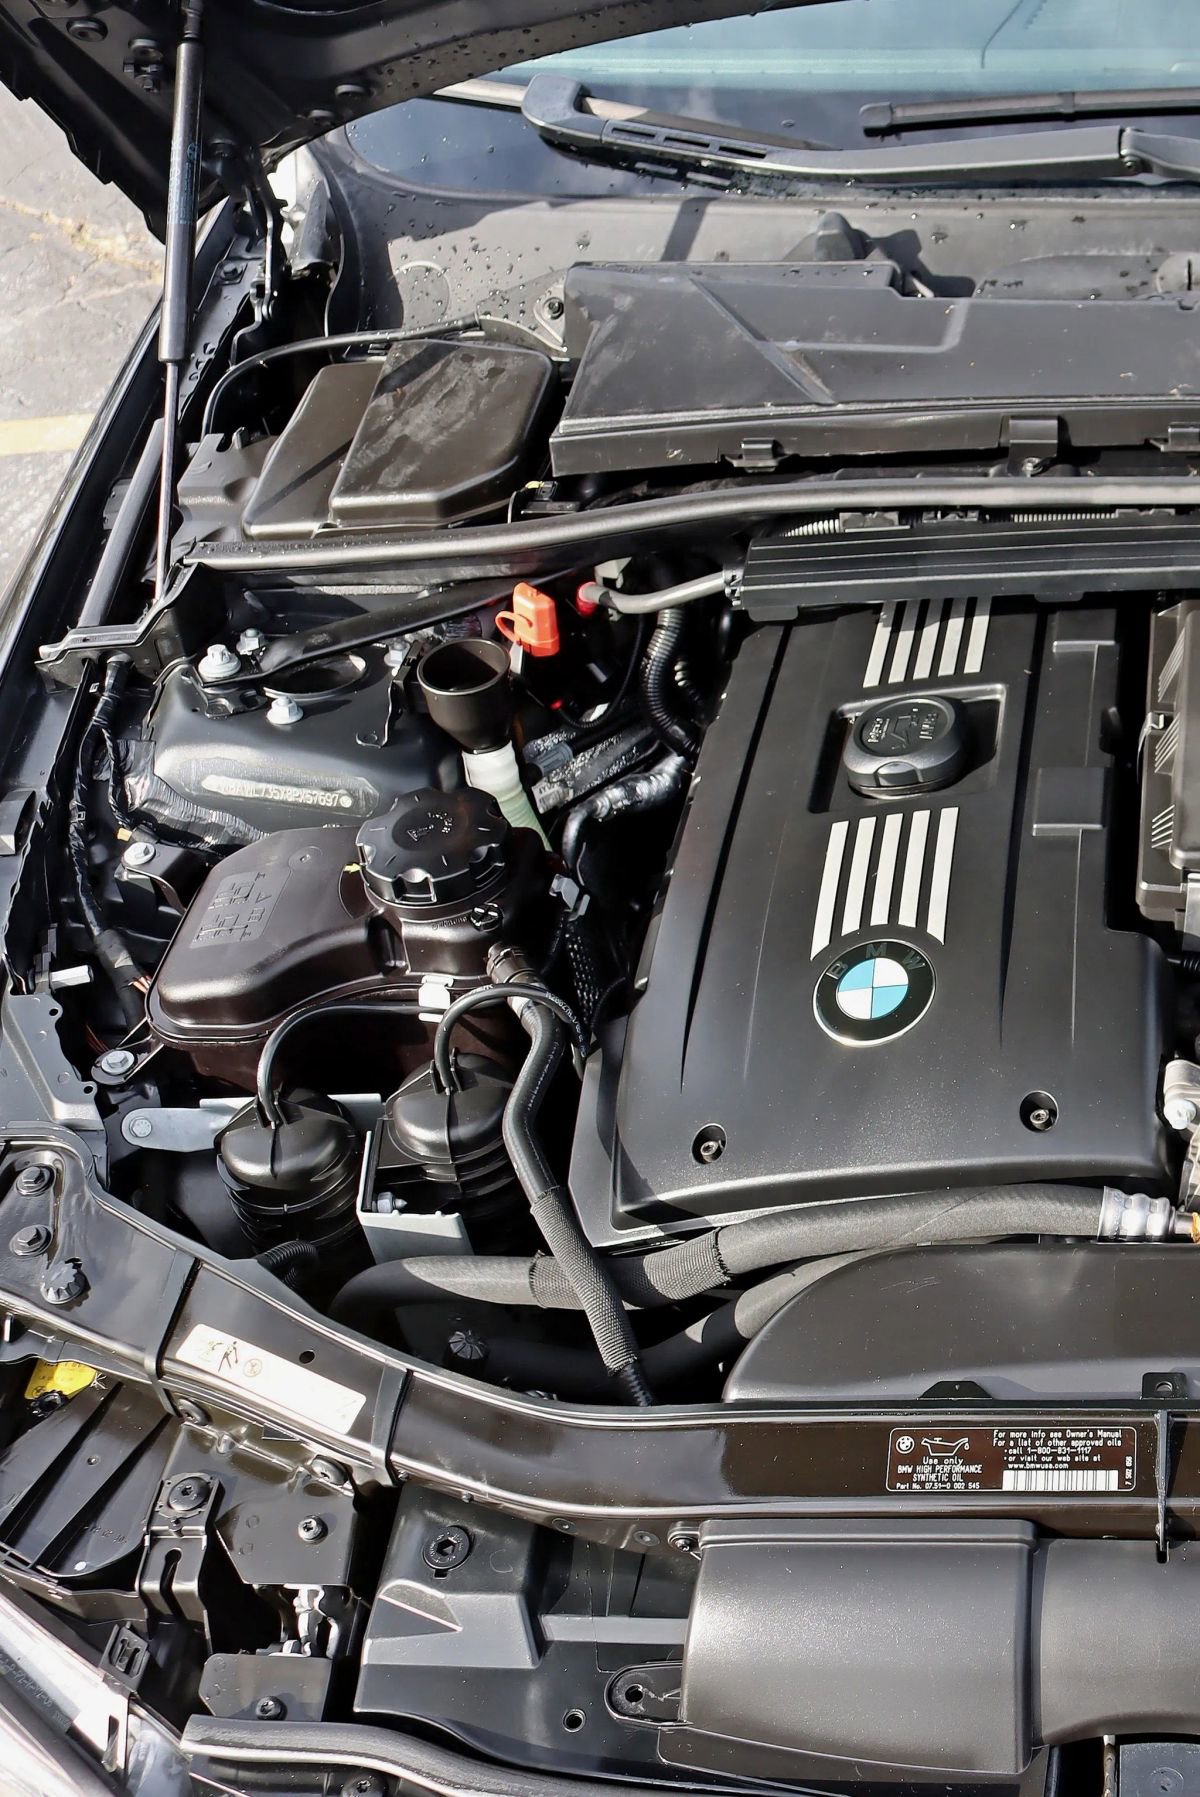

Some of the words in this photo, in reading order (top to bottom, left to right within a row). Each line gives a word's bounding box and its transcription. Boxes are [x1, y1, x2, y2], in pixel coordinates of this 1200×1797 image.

[825, 942, 927, 980] BMW
[993, 1429, 1006, 1438] For
[1031, 1429, 1046, 1438] info
[1066, 1429, 1094, 1438] Owner's
[1097, 1429, 1122, 1438] Manual
[993, 1438, 1006, 1447] For
[1018, 1438, 1031, 1447] list
[1035, 1438, 1044, 1447] of
[1047, 1438, 1067, 1447] other
[1071, 1437, 1104, 1448] approved
[1107, 1438, 1122, 1447] oils
[1027, 1446, 1092, 1454] 1-800-831-1117
[922, 1456, 939, 1465] Use
[943, 1456, 964, 1467] only
[1020, 1454, 1037, 1462] visit
[1057, 1454, 1071, 1462] web
[1074, 1454, 1089, 1462] site
[1093, 1454, 1101, 1462] at
[897, 1464, 913, 1474] BMW
[916, 1464, 933, 1474] HIGH
[935, 1464, 983, 1474] PERFORMANCE
[1008, 1461, 1069, 1469] www.bmwusa.com
[912, 1473, 949, 1482] SYNTHETIC
[952, 1473, 964, 1482] OIL
[896, 1482, 910, 1490] Part
[912, 1482, 922, 1490] No.
[953, 1482, 965, 1490] 002
[968, 1482, 980, 1490] 545
